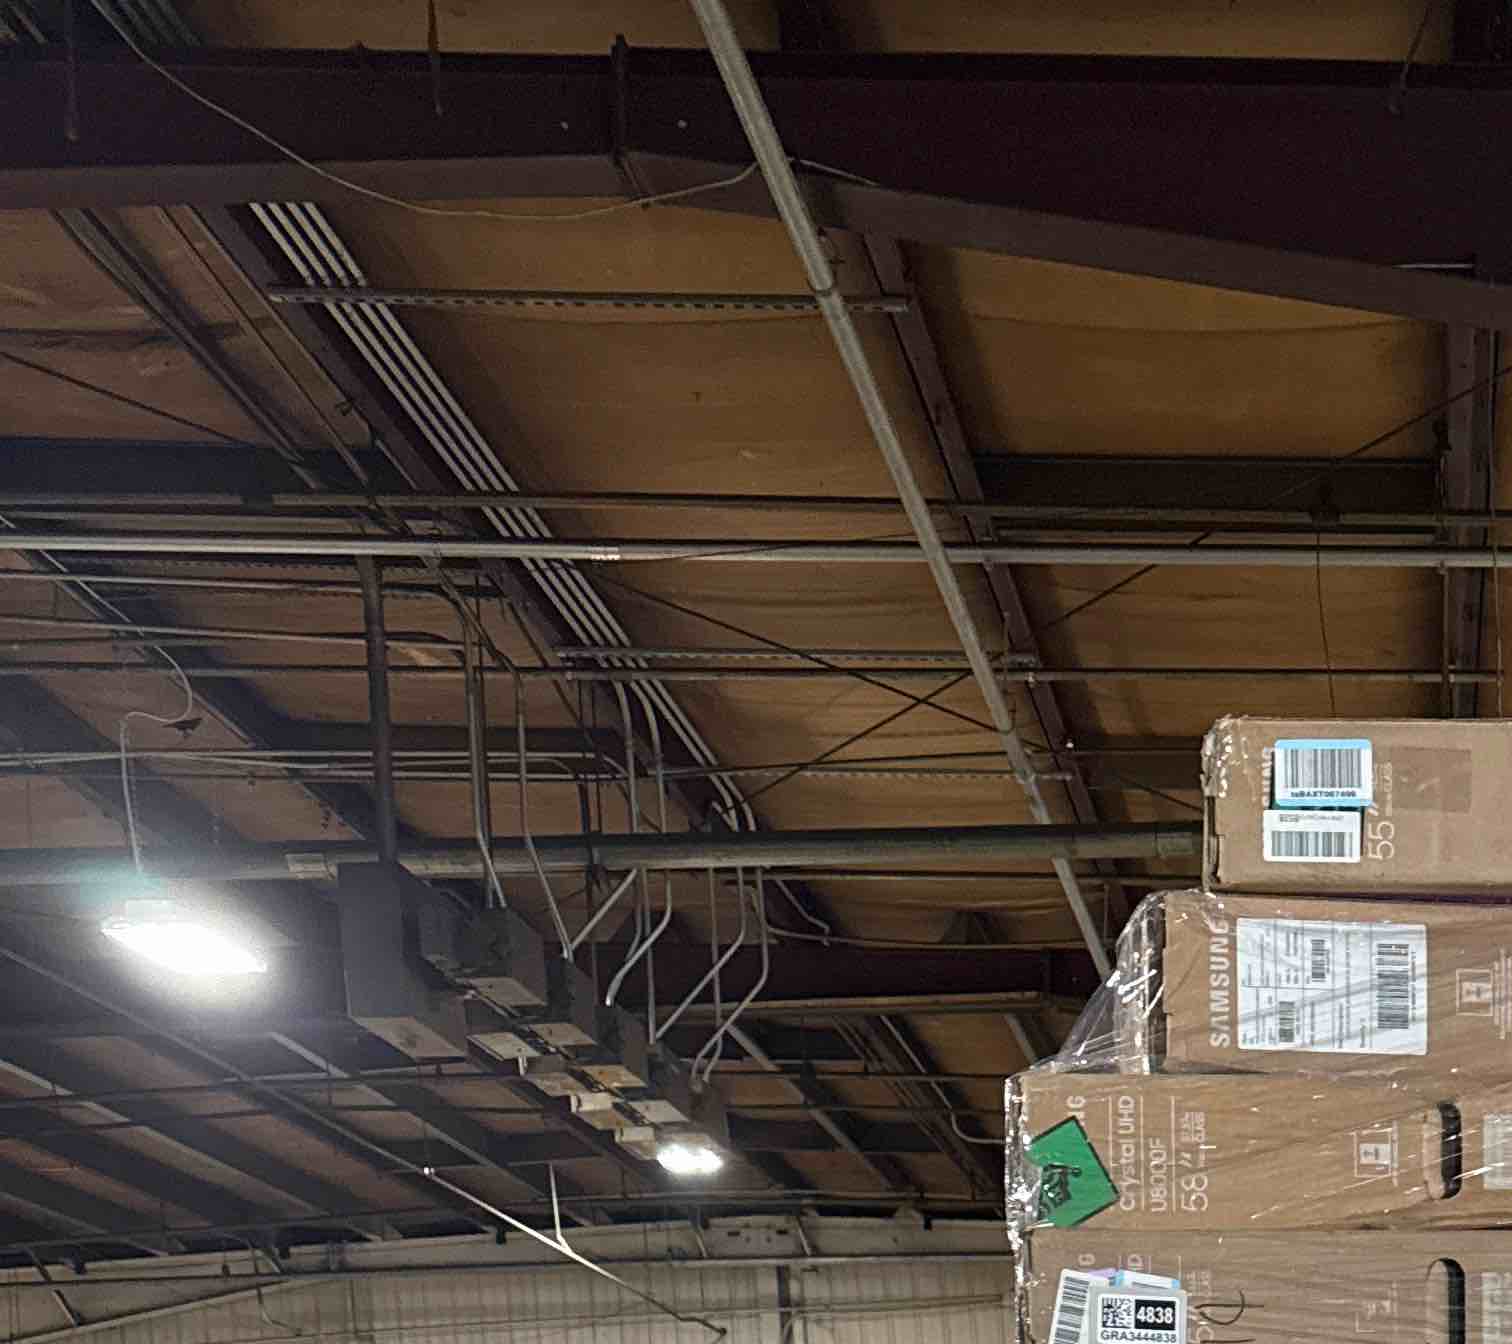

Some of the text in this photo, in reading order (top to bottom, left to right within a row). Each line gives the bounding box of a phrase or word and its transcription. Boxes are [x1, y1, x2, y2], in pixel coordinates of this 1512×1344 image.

[1209, 918, 1231, 1049] SAMSUNG
[1118, 1095, 1141, 1211] Crystal UHD
[1135, 1306, 1175, 1325] 4838
